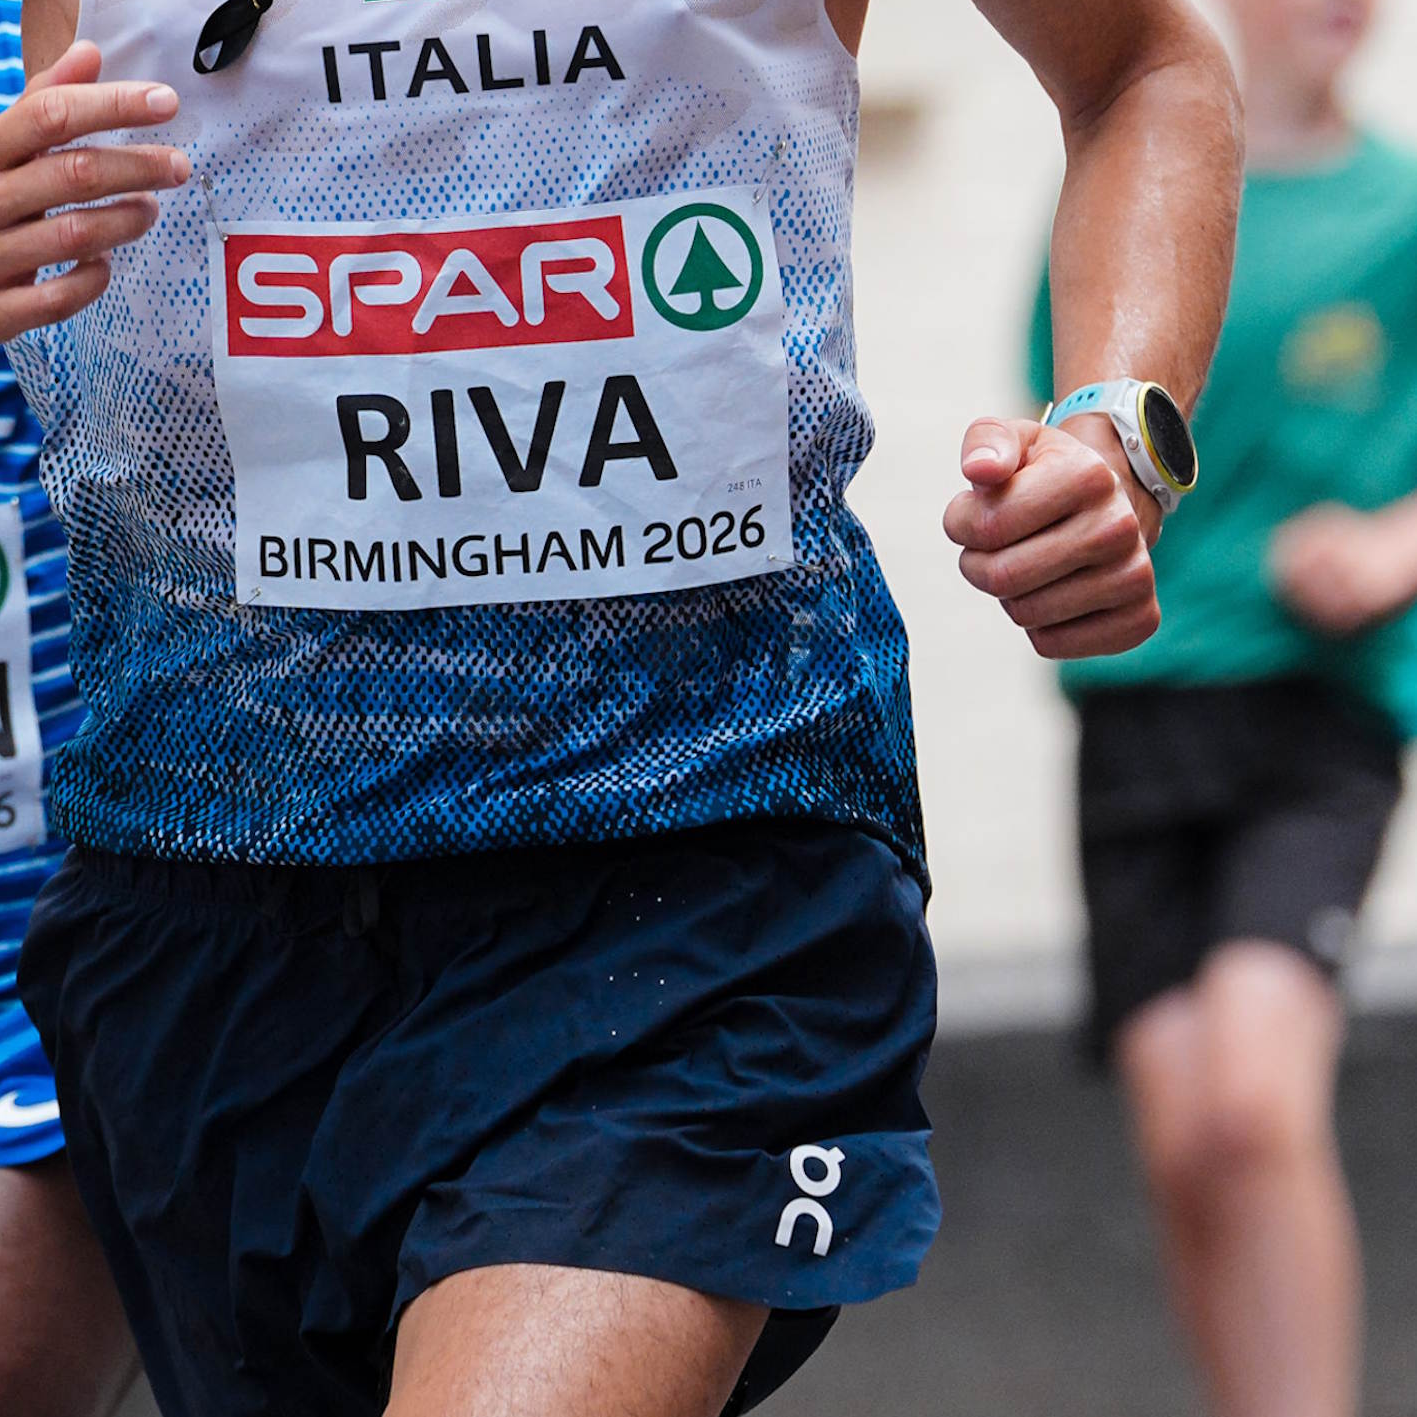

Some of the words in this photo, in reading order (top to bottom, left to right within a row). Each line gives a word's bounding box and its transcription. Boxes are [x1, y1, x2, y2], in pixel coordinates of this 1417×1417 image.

[322, 25, 626, 103] ITALIA
[236, 236, 621, 339] SPAR
[335, 374, 678, 502] RIVA
[259, 524, 626, 584] BIRMINGHAM
[643, 503, 766, 565] 2026
